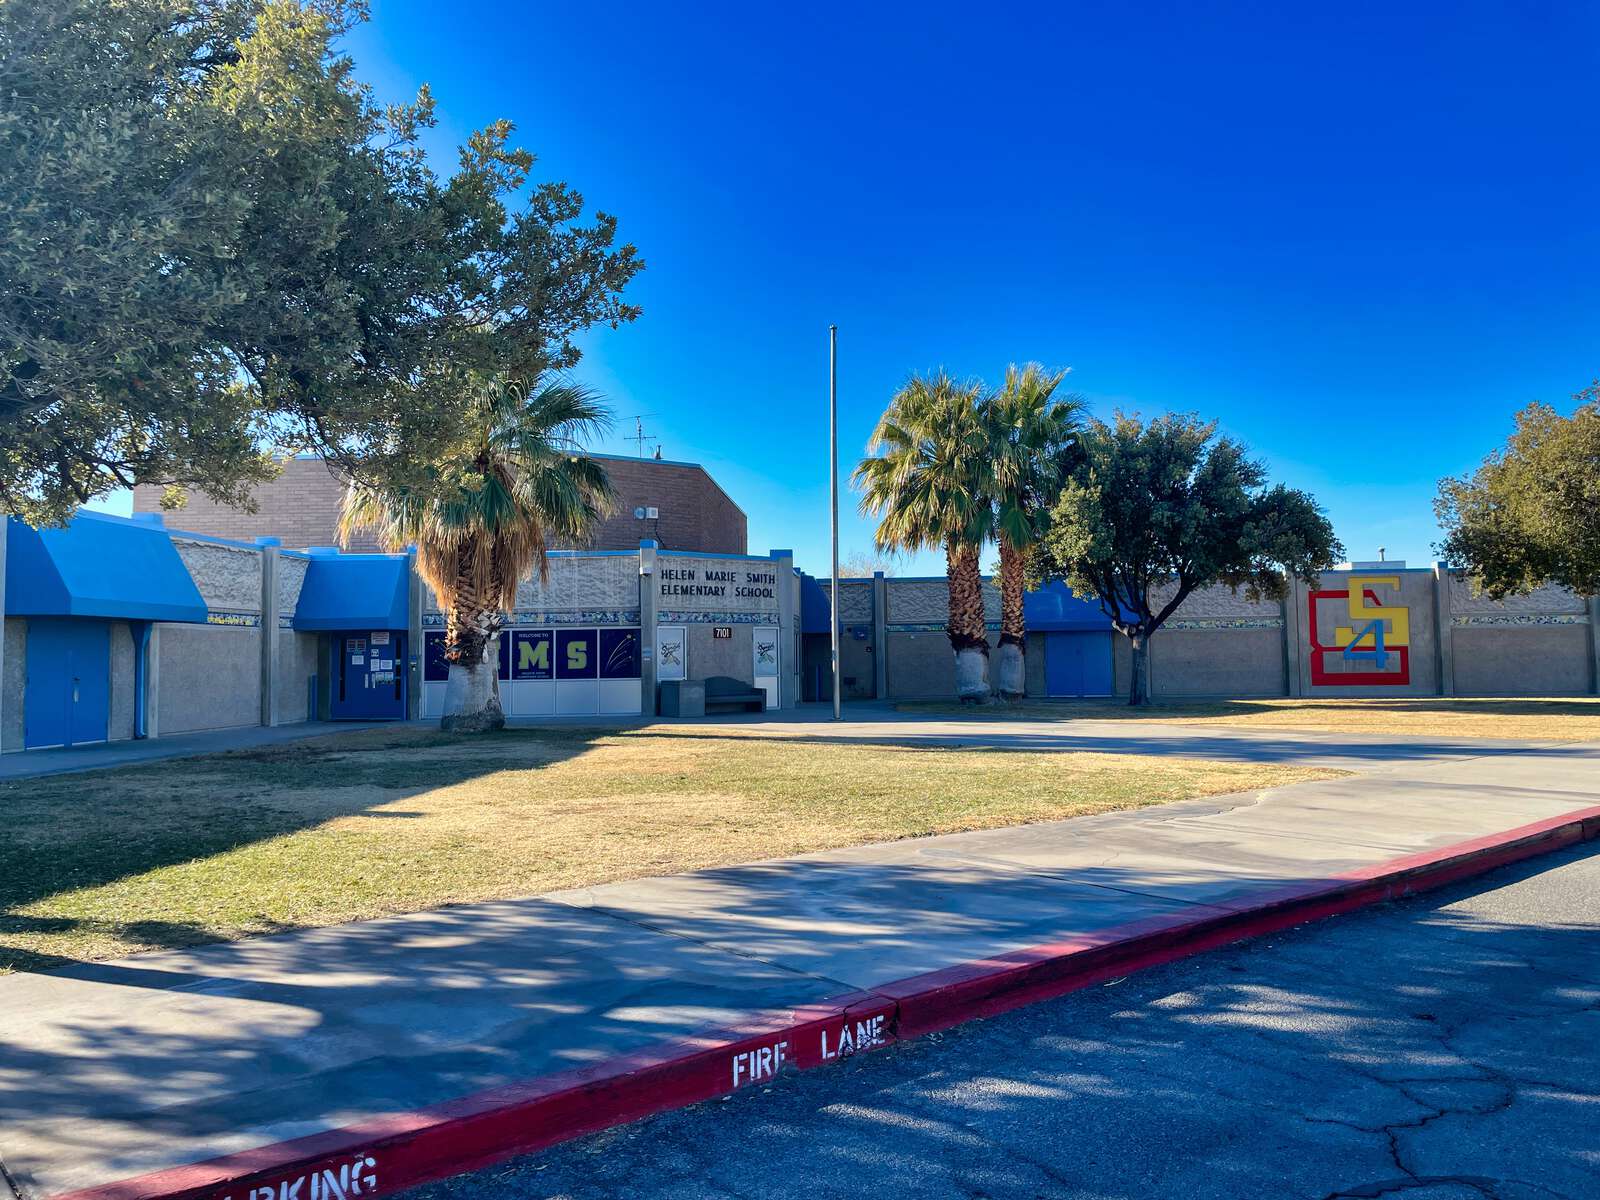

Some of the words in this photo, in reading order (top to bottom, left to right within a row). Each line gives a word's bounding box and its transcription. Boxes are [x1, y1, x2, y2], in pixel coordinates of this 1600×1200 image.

[661, 569, 695, 580] HELEN
[705, 570, 737, 582] MARIE
[746, 572, 775, 584] SMITH
[661, 584, 726, 596] ELEMENTARY
[735, 586, 775, 598] SCHOOL
[715, 628, 729, 638] 7101
[518, 641, 549, 670] M
[567, 641, 587, 670] S
[821, 1015, 885, 1059] LANE
